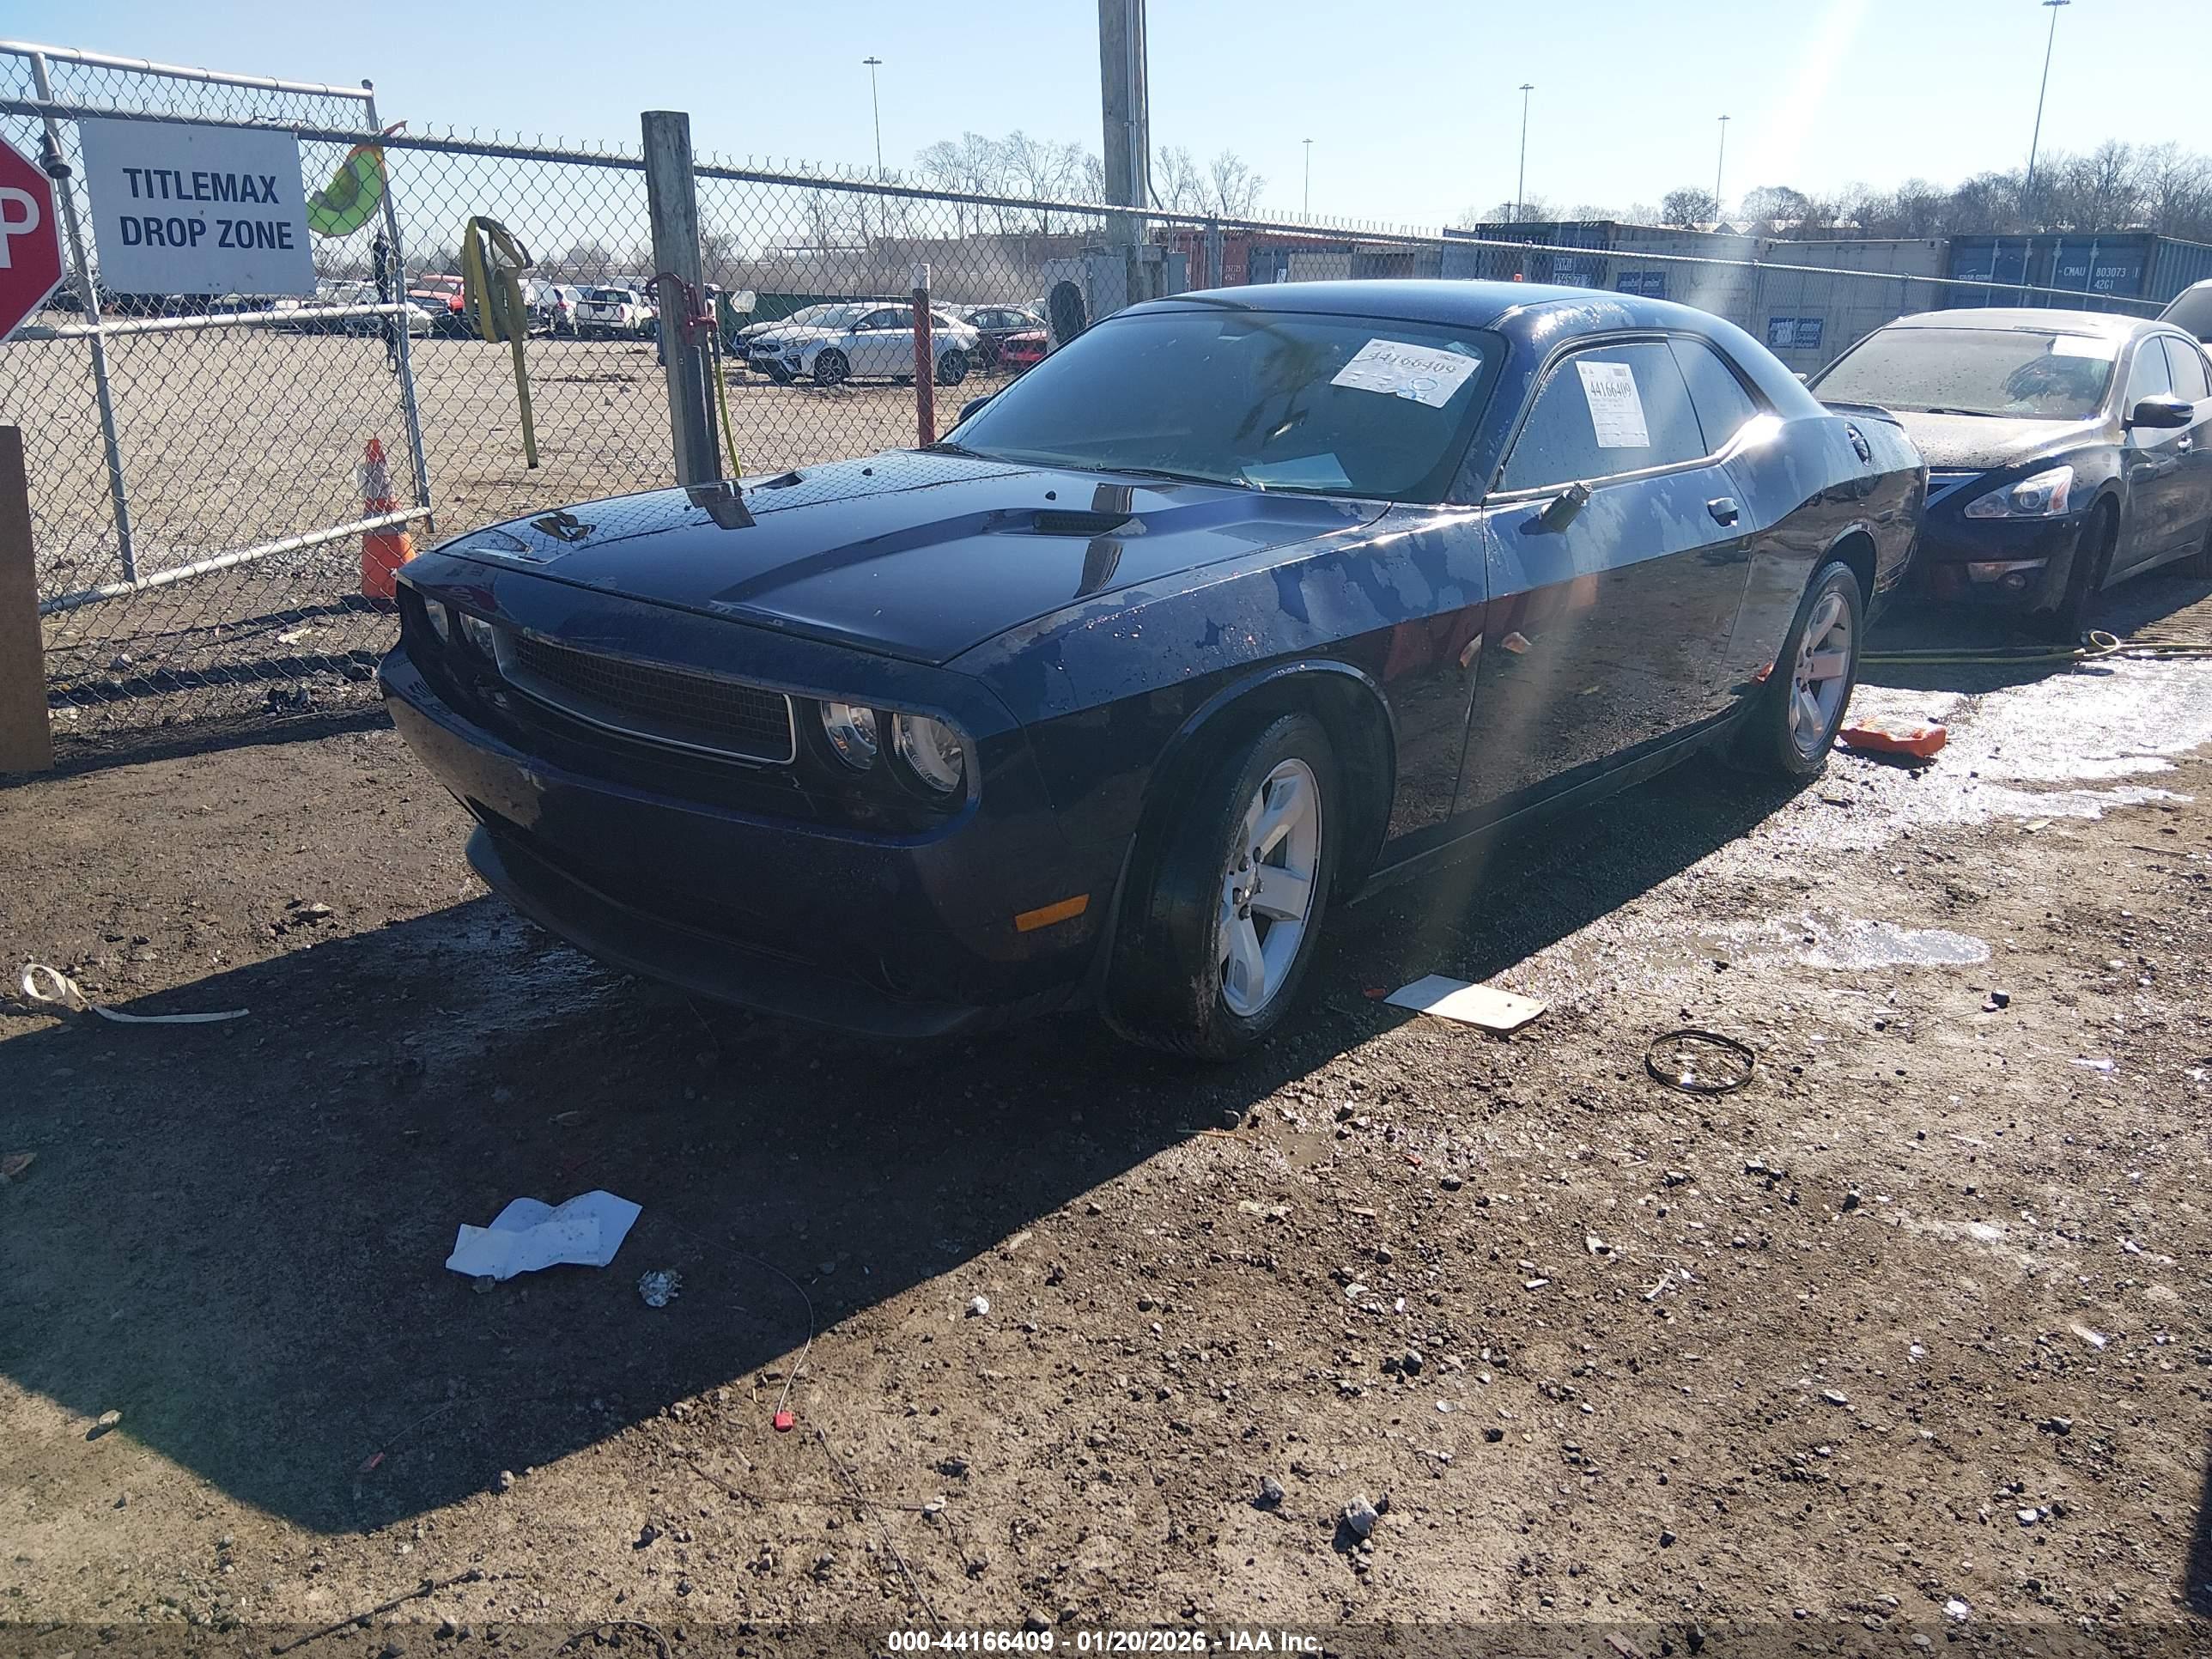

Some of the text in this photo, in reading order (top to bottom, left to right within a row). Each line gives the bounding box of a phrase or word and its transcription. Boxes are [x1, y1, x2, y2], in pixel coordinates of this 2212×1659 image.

[122, 167, 280, 204] TITLEMAX
[119, 216, 295, 250] DROP ZONE
[2063, 266, 2087, 276] CMAU
[2095, 267, 2127, 277] 803073
[1590, 380, 1632, 398] 44166409
